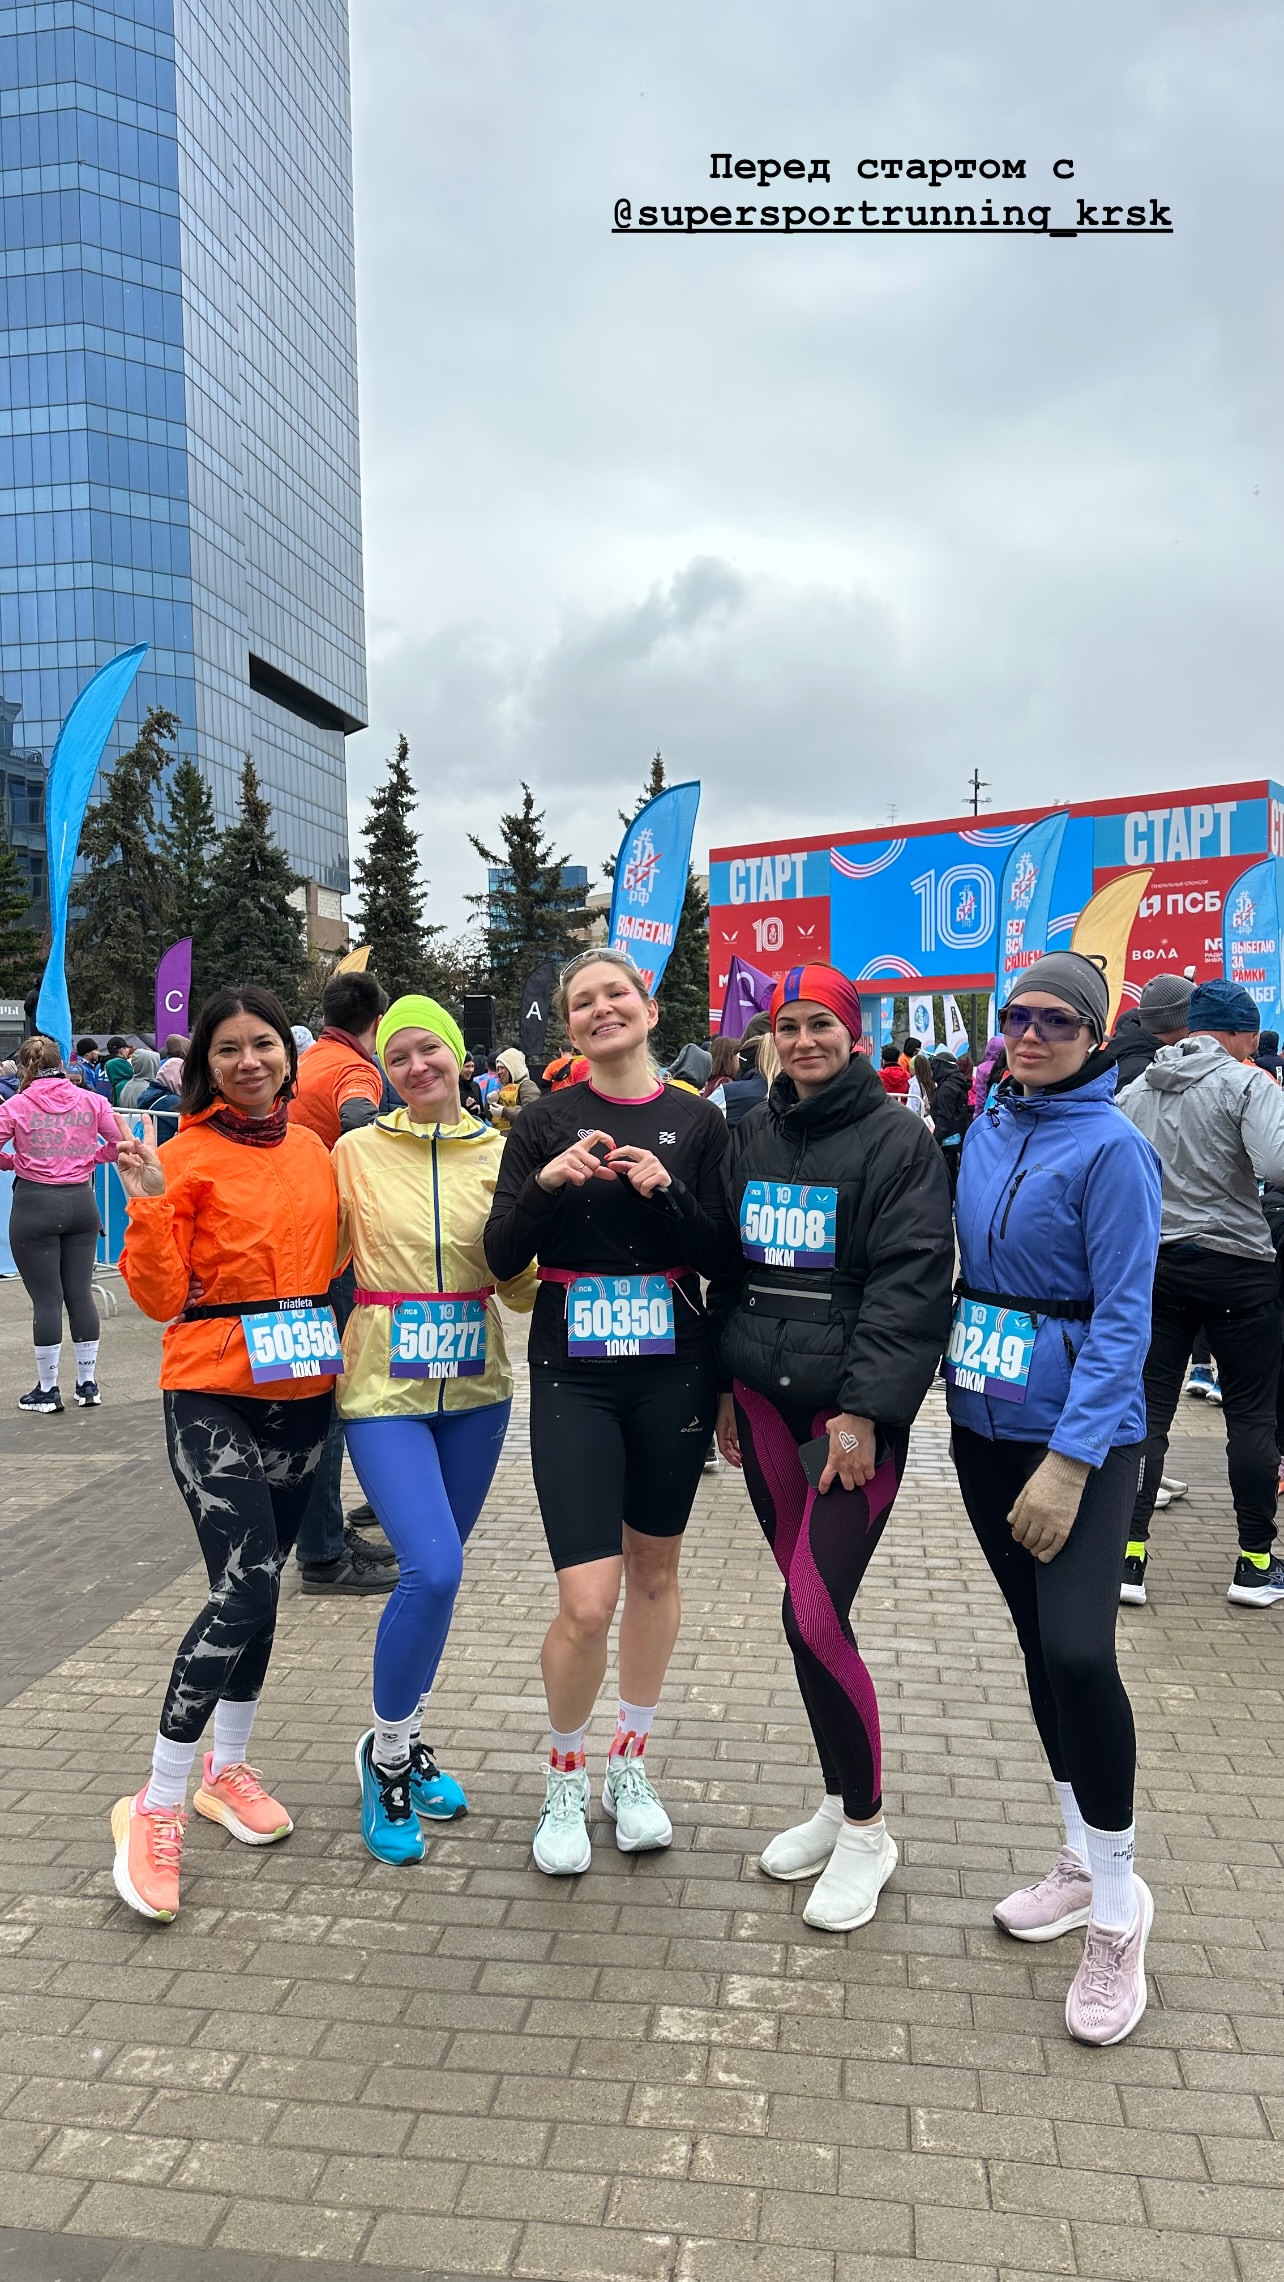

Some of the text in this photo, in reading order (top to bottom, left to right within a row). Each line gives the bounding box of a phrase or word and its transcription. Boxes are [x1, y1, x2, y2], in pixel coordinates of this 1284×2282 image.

[1124, 801, 1237, 866] СТАРТ
[729, 852, 808, 905] СТАРТ
[910, 863, 996, 953] 10
[1166, 890, 1222, 915] ПСБ
[752, 916, 784, 953] 10
[1231, 939, 1276, 954] ВЫБЕГАЮ
[1231, 954, 1245, 969] ЗА
[1231, 969, 1266, 982] РАМКИ
[31, 1111, 94, 1129] БЕГАЮ
[745, 1203, 826, 1249] 50108
[278, 1298, 313, 1310] Triatleta
[574, 1298, 669, 1338] 50350
[251, 1320, 338, 1364] 50358
[399, 1321, 481, 1360] 50277
[946, 1320, 1025, 1379] 0249
